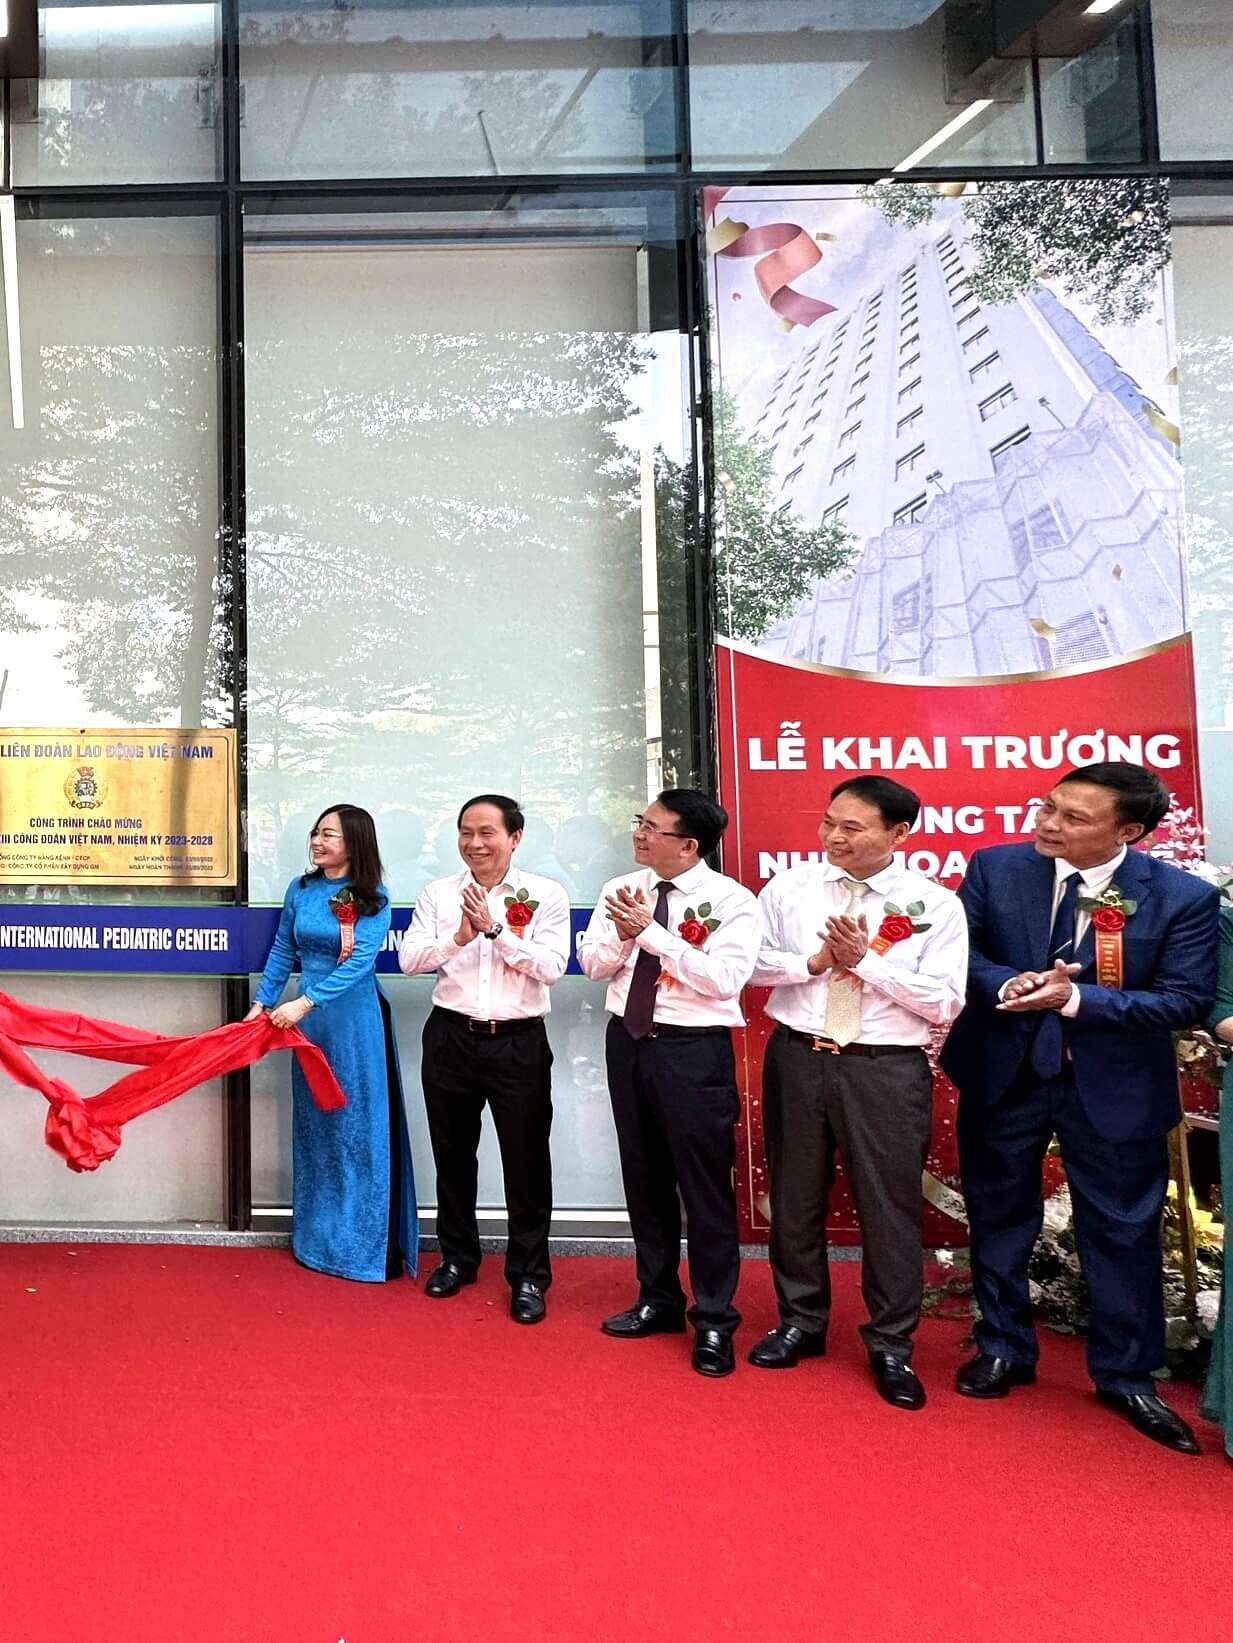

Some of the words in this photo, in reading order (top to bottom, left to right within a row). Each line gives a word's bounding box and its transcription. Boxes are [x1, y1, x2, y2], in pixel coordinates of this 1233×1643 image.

[0, 742, 30, 758] LIÊN
[34, 742, 72, 758] ĐOÀN
[77, 744, 101, 758] LAO
[148, 742, 176, 761] VIỆT
[181, 745, 213, 758] NAM
[749, 721, 806, 770] LỄ
[823, 737, 947, 769] KHAI
[961, 728, 1181, 769] TRƯƠNG
[29, 816, 55, 828] CÔNG
[58, 816, 84, 828] TRÌNH
[995, 798, 1038, 833] TÂ
[13, 832, 38, 844] CÔNG
[69, 833, 89, 846] VIỆT
[164, 835, 213, 846] 2023-2028
[103, 927, 172, 950] PEDIATRIC
[175, 928, 229, 951] CENTER
